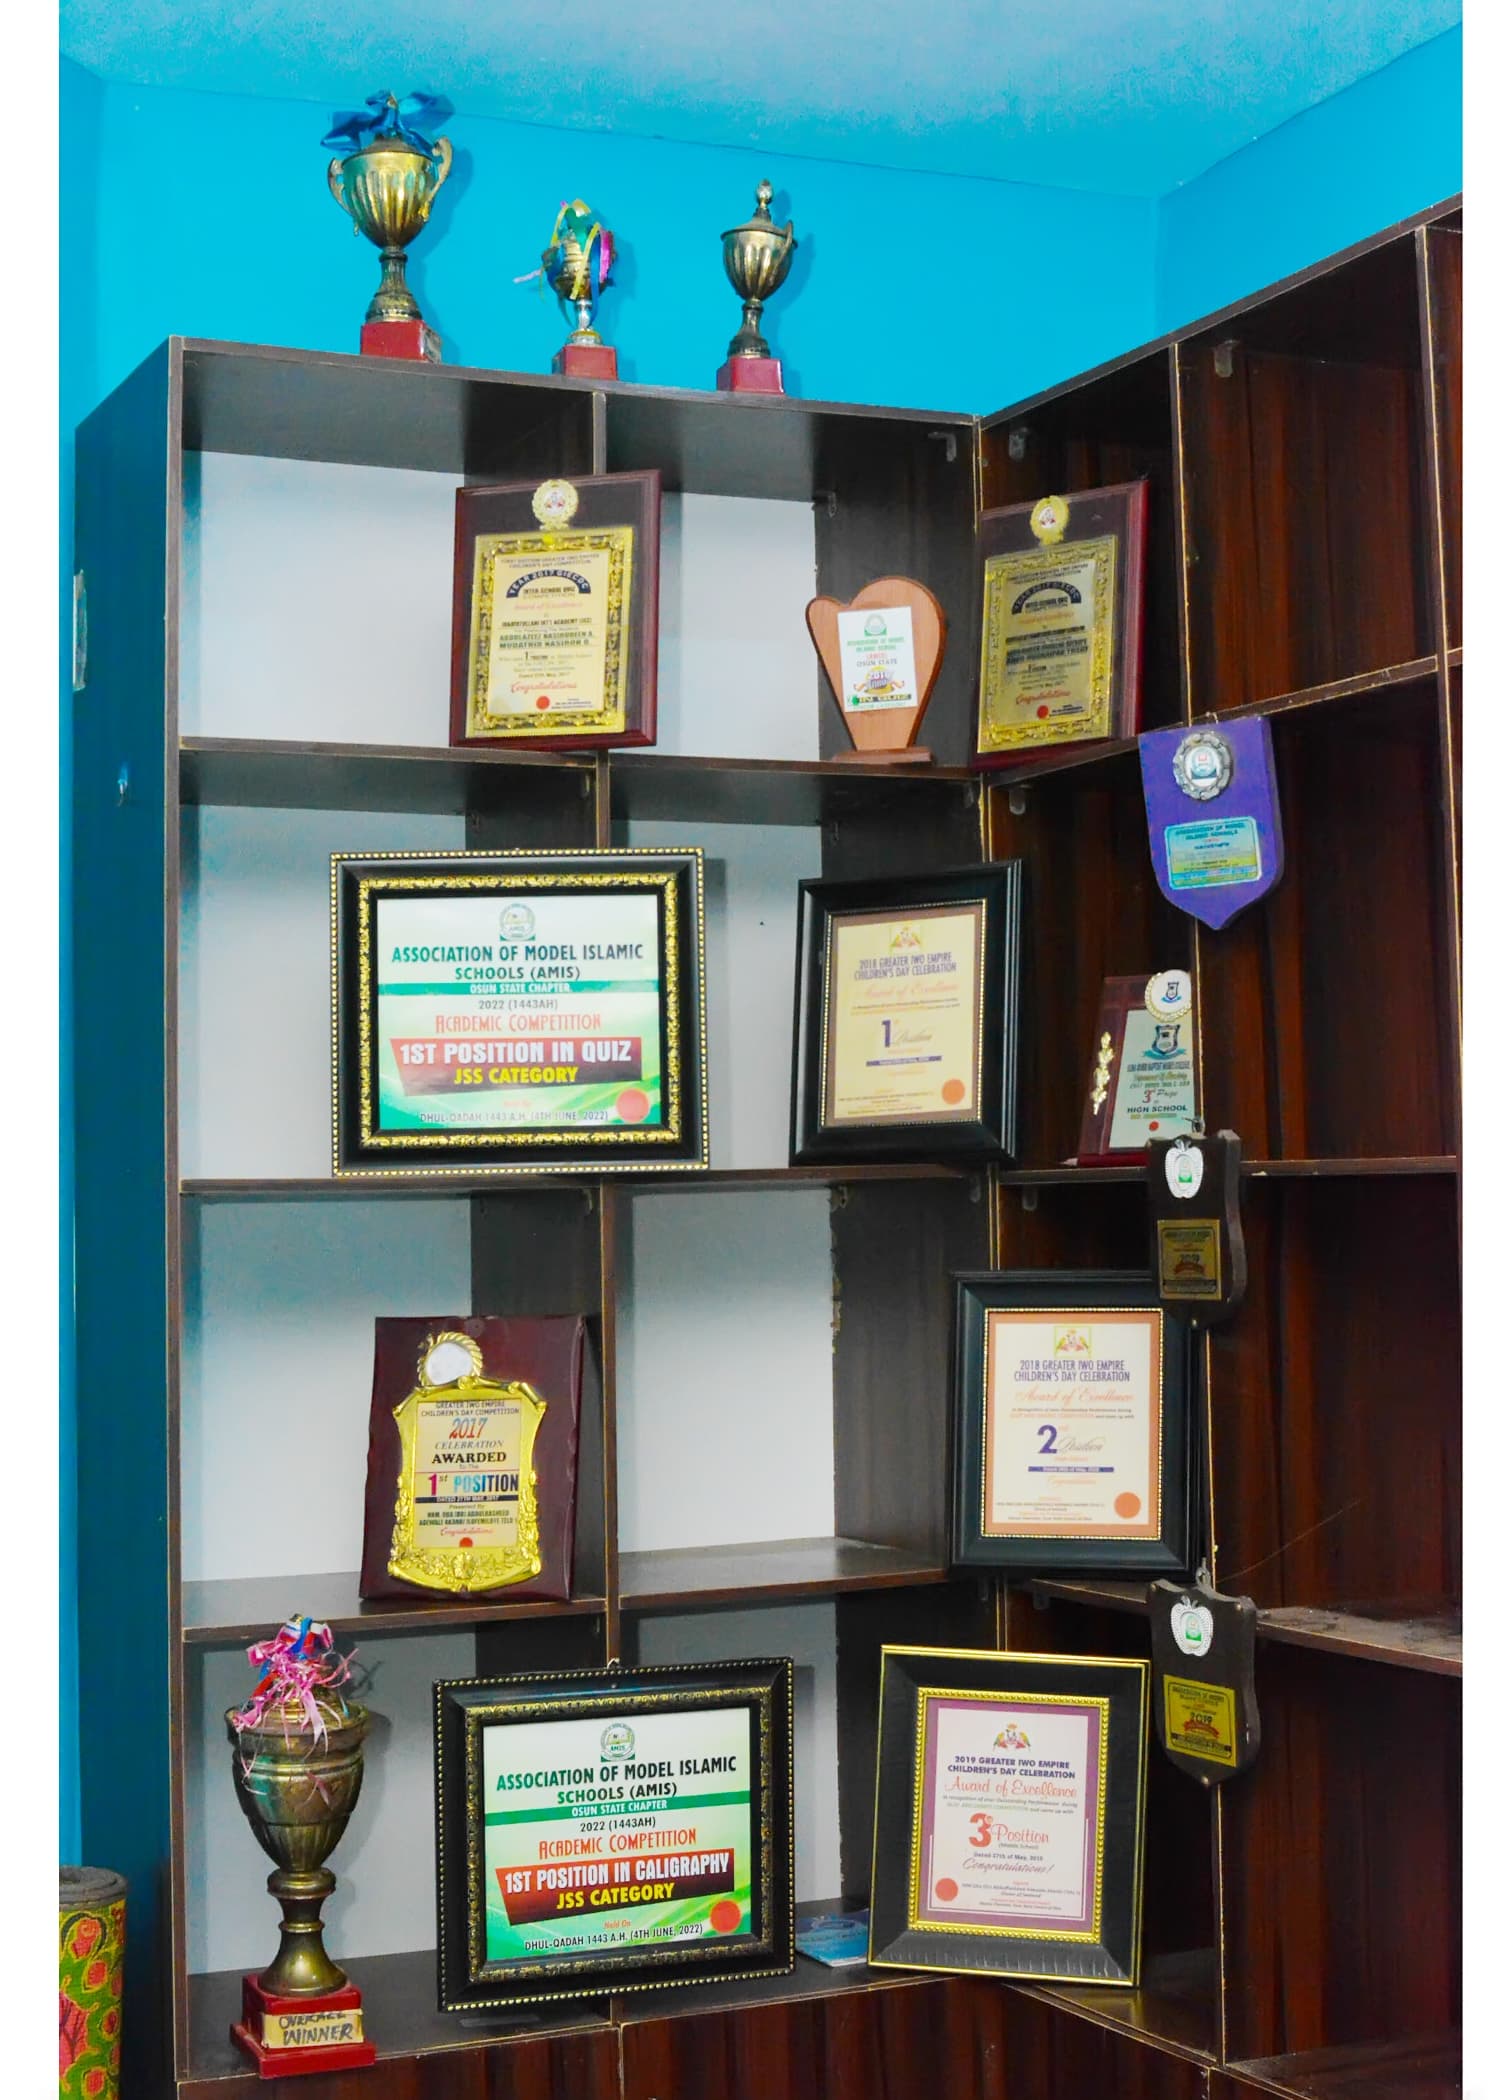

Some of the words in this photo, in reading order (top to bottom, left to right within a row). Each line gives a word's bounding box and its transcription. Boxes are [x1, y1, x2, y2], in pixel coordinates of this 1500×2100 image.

[391, 946, 492, 963] ASSOCIATION
[499, 946, 518, 961] OF
[525, 945, 576, 961] MODEL
[583, 944, 643, 960] ISLAMIC
[455, 967, 524, 980] SCHOOLS
[530, 966, 580, 981] (AMIS)
[470, 983, 497, 994] OSUN
[499, 983, 526, 994] STATE
[528, 982, 571, 993] CHAPTER
[478, 1000, 505, 1010] 2022
[508, 999, 558, 1010] (1443AH)
[436, 1014, 502, 1033] ACADEMIC
[509, 1013, 601, 1032] COMPETITION
[400, 1042, 437, 1065] 1ST
[444, 1041, 544, 1064] POSITION
[551, 1040, 574, 1063] IN
[581, 1040, 632, 1063] QUIZ
[454, 1067, 484, 1084] JSS
[488, 1066, 579, 1084] CATEGORY
[583, 1110, 608, 1122] 2022)
[1151, 1104, 1187, 1113] SCHOOL
[1020, 1359, 1040, 1371] 2018
[1042, 1359, 1075, 1371] GREATER
[1096, 1359, 1125, 1371] EMPIRE
[1014, 1371, 1059, 1382] CHILDREN'S
[1061, 1371, 1077, 1382] DAY
[1080, 1371, 1130, 1382] CELEBRATION
[476, 1408, 520, 1416] COMPETITION
[449, 1417, 488, 1439] 2017
[435, 1440, 504, 1450] CELEBRATION
[431, 1451, 507, 1464] AWARDED
[454, 1473, 519, 1493] POSITION
[955, 1755, 976, 1764] 2019
[979, 1757, 1016, 1767] GREATER
[1018, 1759, 1036, 1768] IWO
[1038, 1760, 1070, 1770] EMPIRE
[497, 1768, 594, 1791] ASSOCIATION
[600, 1765, 619, 1782] OF
[624, 1761, 674, 1780] MODEL
[679, 1756, 737, 1776] ISLAMIC
[947, 1764, 998, 1775] CHILDREN'S
[1000, 1768, 1017, 1776] DAY
[1019, 1769, 1075, 1780] CELEBRATION
[557, 1786, 624, 1804] SCHOOLS
[630, 1782, 677, 1801] (AMIS)
[944, 1775, 990, 1793] Award
[995, 1779, 1009, 1798] of
[1011, 1779, 1077, 1799] Excellence
[571, 1805, 599, 1817] OSUN
[600, 1803, 625, 1815] STATE
[628, 1799, 668, 1812] CHAPTER
[580, 1821, 605, 1833] 2022
[609, 1817, 656, 1832] (1443AH)
[991, 1823, 1050, 1845] Position
[539, 1837, 602, 1860] ACADEMIC
[609, 1828, 697, 1853] COMPETITION
[504, 1870, 532, 1894] 1ST
[537, 1863, 609, 1892] POSITION
[614, 1861, 631, 1884] IN
[635, 1852, 730, 1881] CALIGRAPHY
[962, 1857, 1055, 1873] Congratulations!
[556, 1890, 585, 1910] JSS
[590, 1882, 676, 1906] CATEGORY
[524, 1935, 584, 1951] DHUL-QADAH
[586, 1933, 608, 1945] 1443
[610, 1931, 628, 1943] A.H.
[630, 1929, 651, 1942] (4TH
[652, 1926, 676, 1938] JUNE,
[679, 1924, 703, 1937] 2022)
[283, 2023, 353, 2046] WINNER
